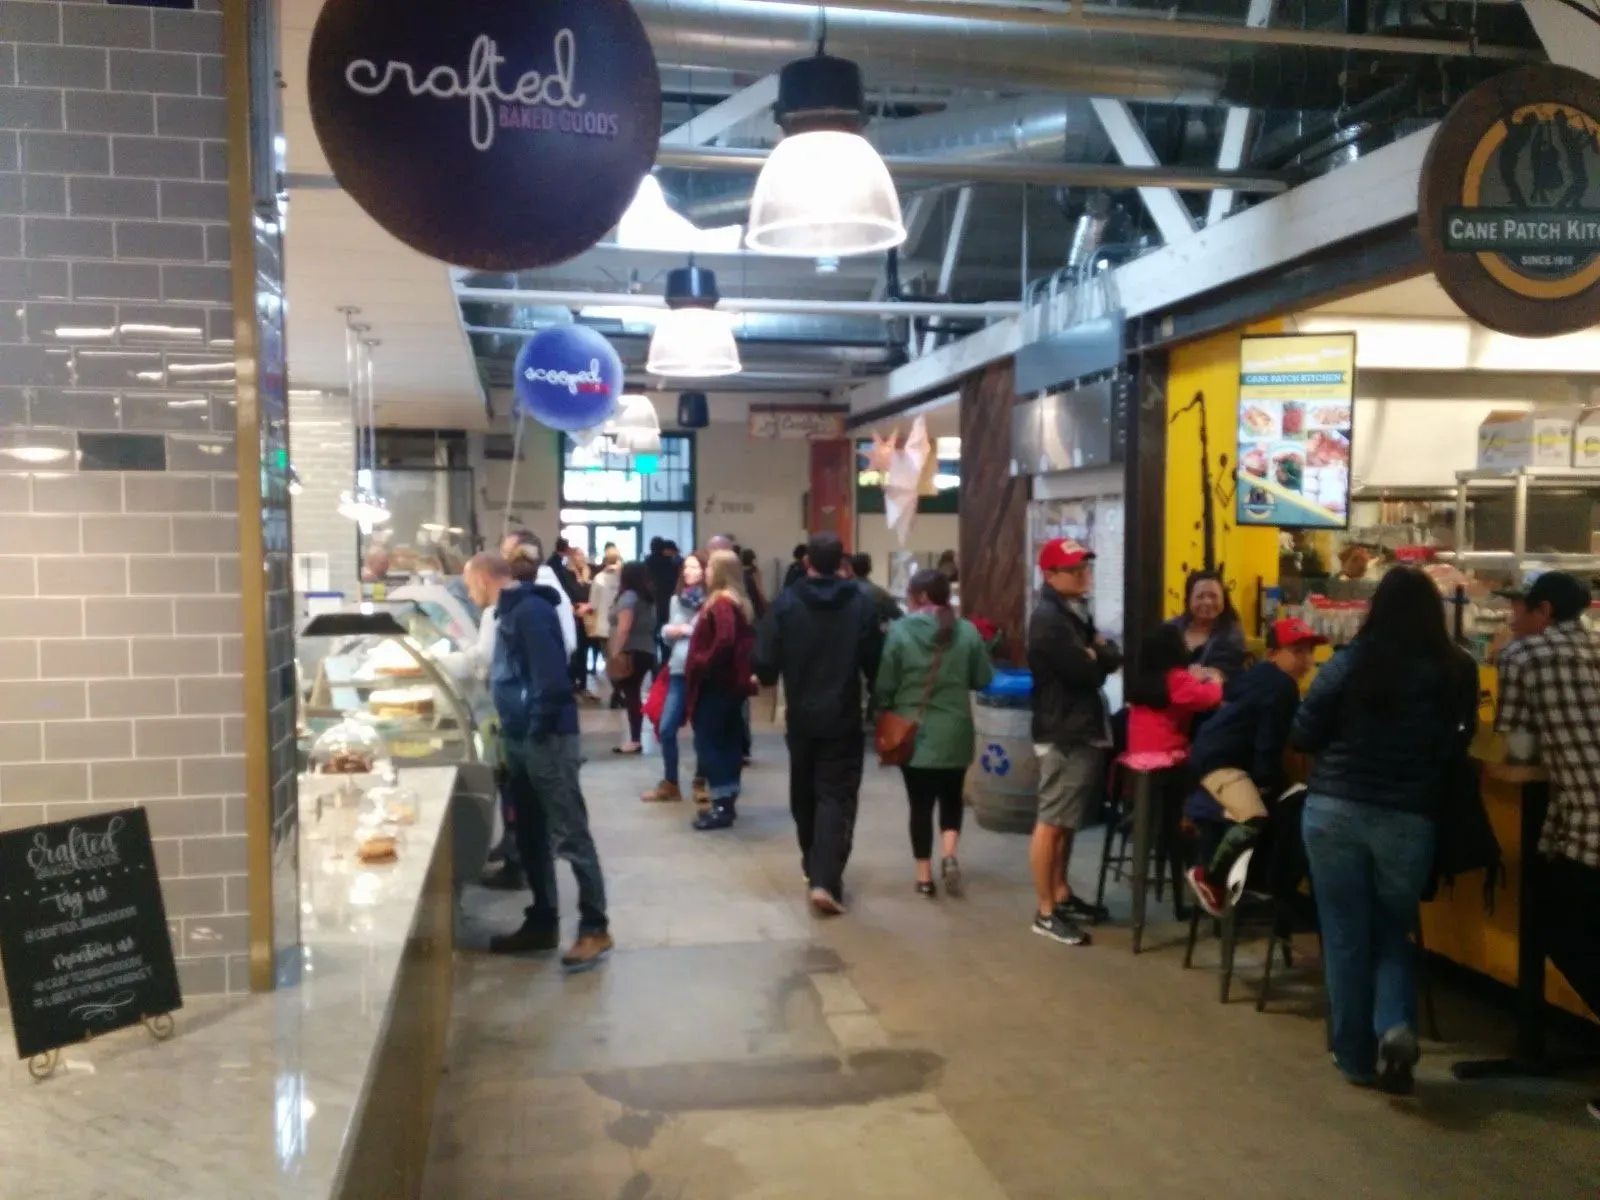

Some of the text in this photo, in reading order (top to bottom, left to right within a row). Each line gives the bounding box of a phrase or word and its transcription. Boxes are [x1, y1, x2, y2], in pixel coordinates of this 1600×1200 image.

[346, 28, 586, 150] crafted
[498, 104, 619, 136] BAKED GOODS
[1450, 218, 1600, 241] CANE PATCH KIT
[1520, 255, 1551, 265] SINCE
[524, 358, 602, 395] scooped
[1245, 372, 1342, 383] CANE PATCH KITCHEN
